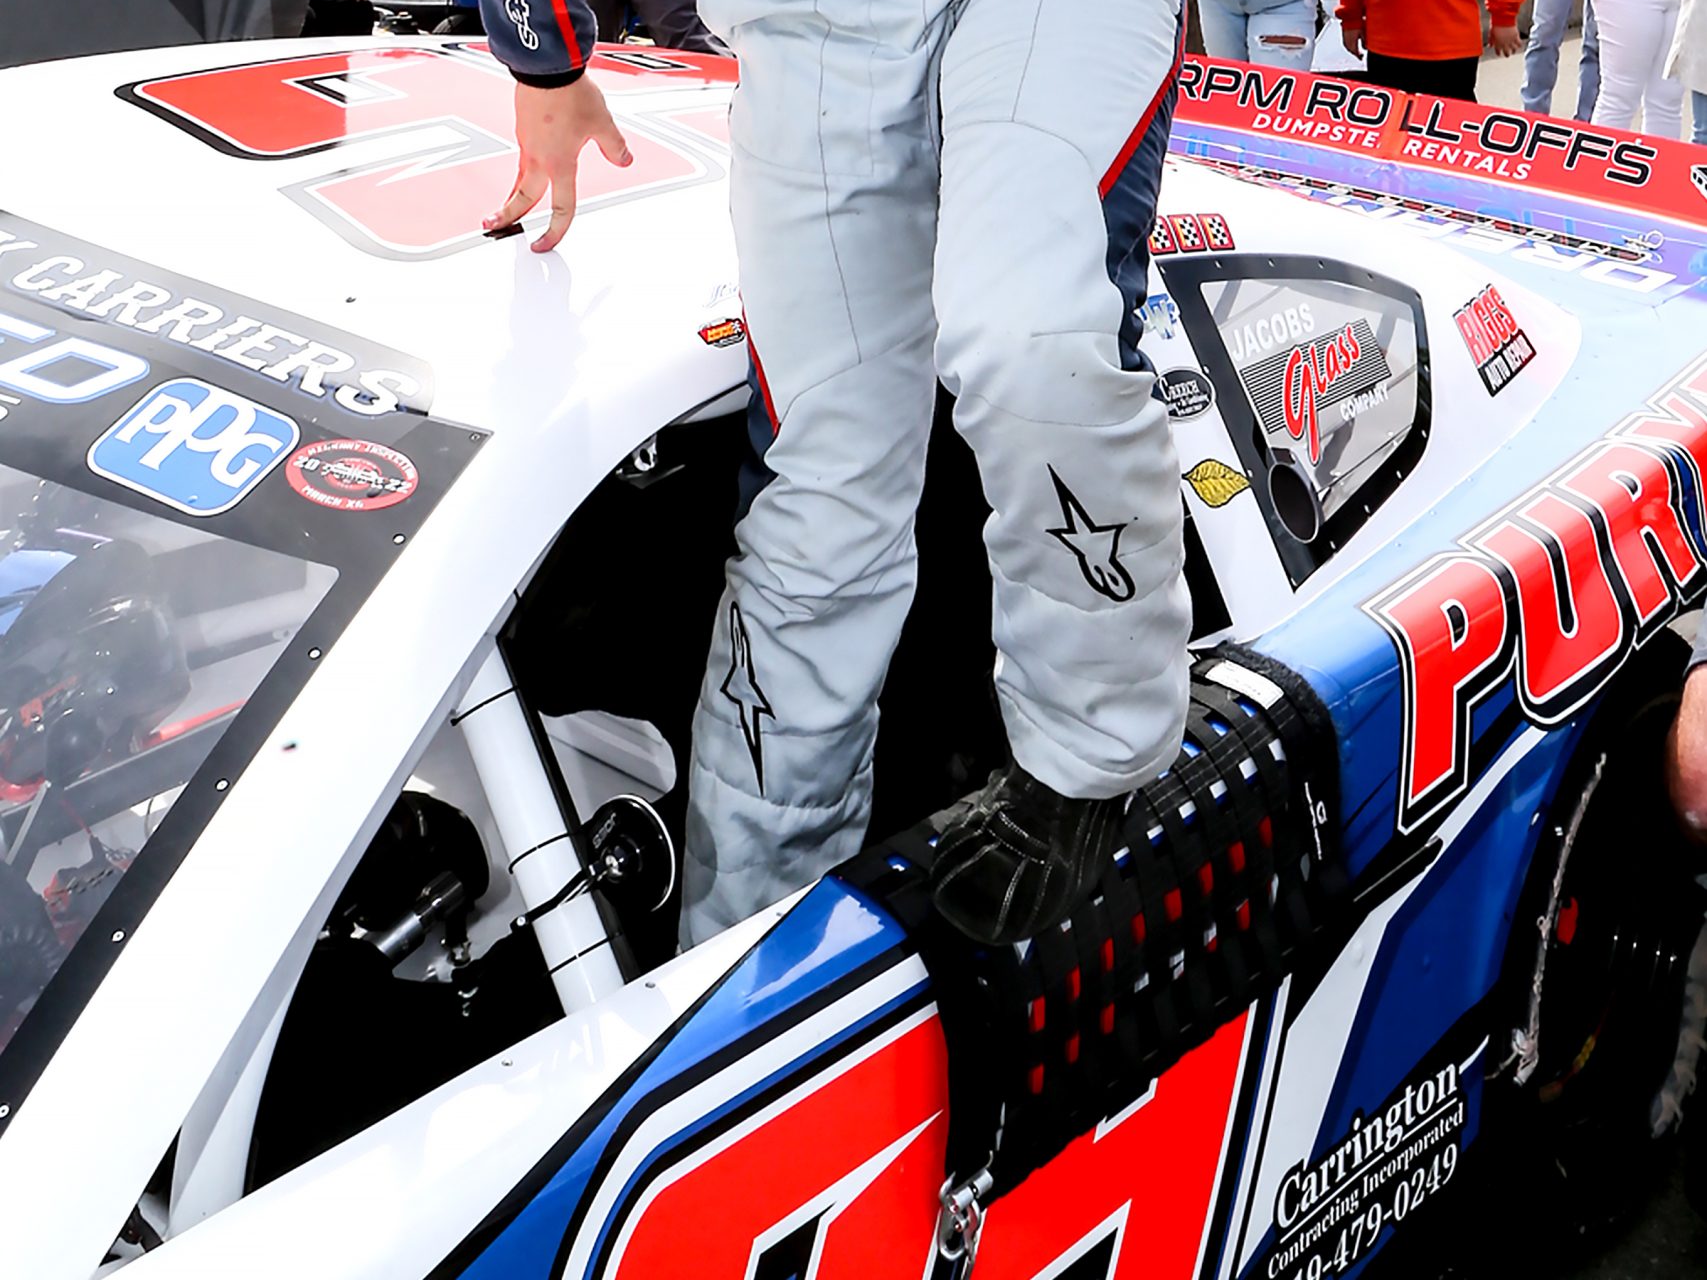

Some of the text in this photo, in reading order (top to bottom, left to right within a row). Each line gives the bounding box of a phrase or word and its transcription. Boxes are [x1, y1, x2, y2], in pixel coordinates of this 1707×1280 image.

[1178, 60, 1297, 114] RPM
[1250, 112, 1533, 181] DUMPSTE RENTALS
[10, 255, 422, 416] CARRIERS
[1231, 303, 1315, 362] JACOBS
[1452, 282, 1518, 369] RIGGS
[113, 378, 285, 490] PPG
[1339, 381, 1389, 422] COMPANY
[1267, 1101, 1464, 1280] Contracting Incorporated
[1276, 1062, 1459, 1229] Carrington
[1293, 1142, 1458, 1280] 9-479-0249
